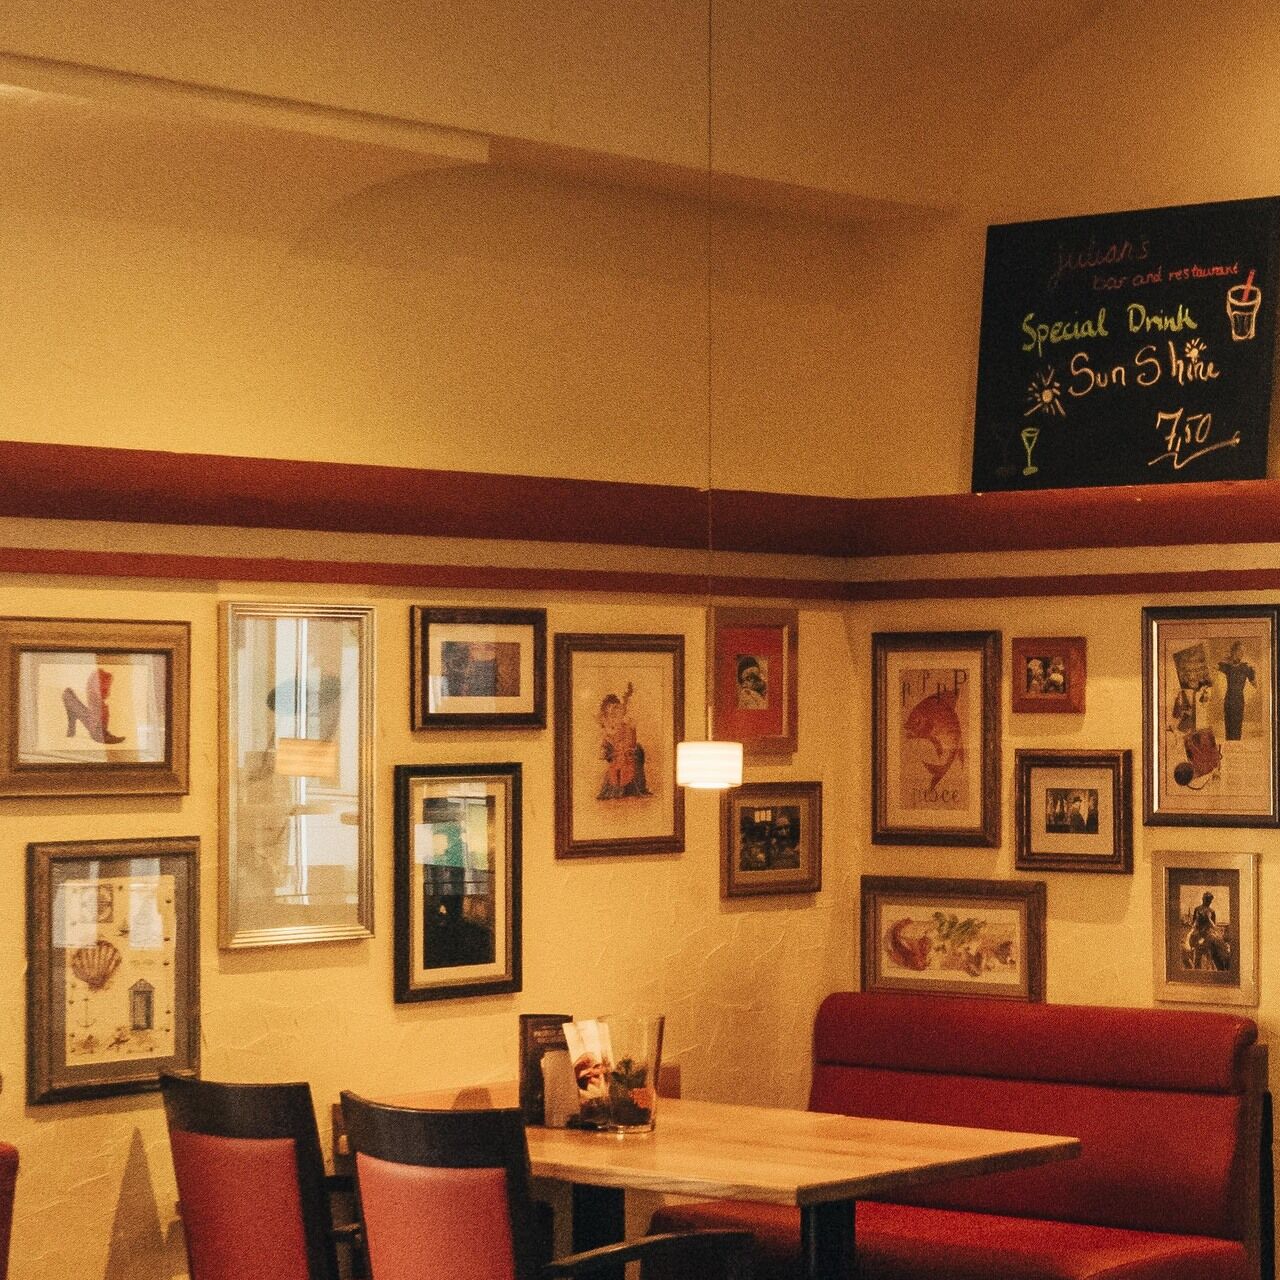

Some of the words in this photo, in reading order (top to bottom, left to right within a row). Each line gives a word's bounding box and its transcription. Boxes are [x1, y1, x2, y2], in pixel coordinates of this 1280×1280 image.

[1132, 266, 1163, 286] and
[1021, 307, 1108, 357] Special
[1126, 303, 1198, 334] Drink
[1068, 352, 1126, 397] Sun
